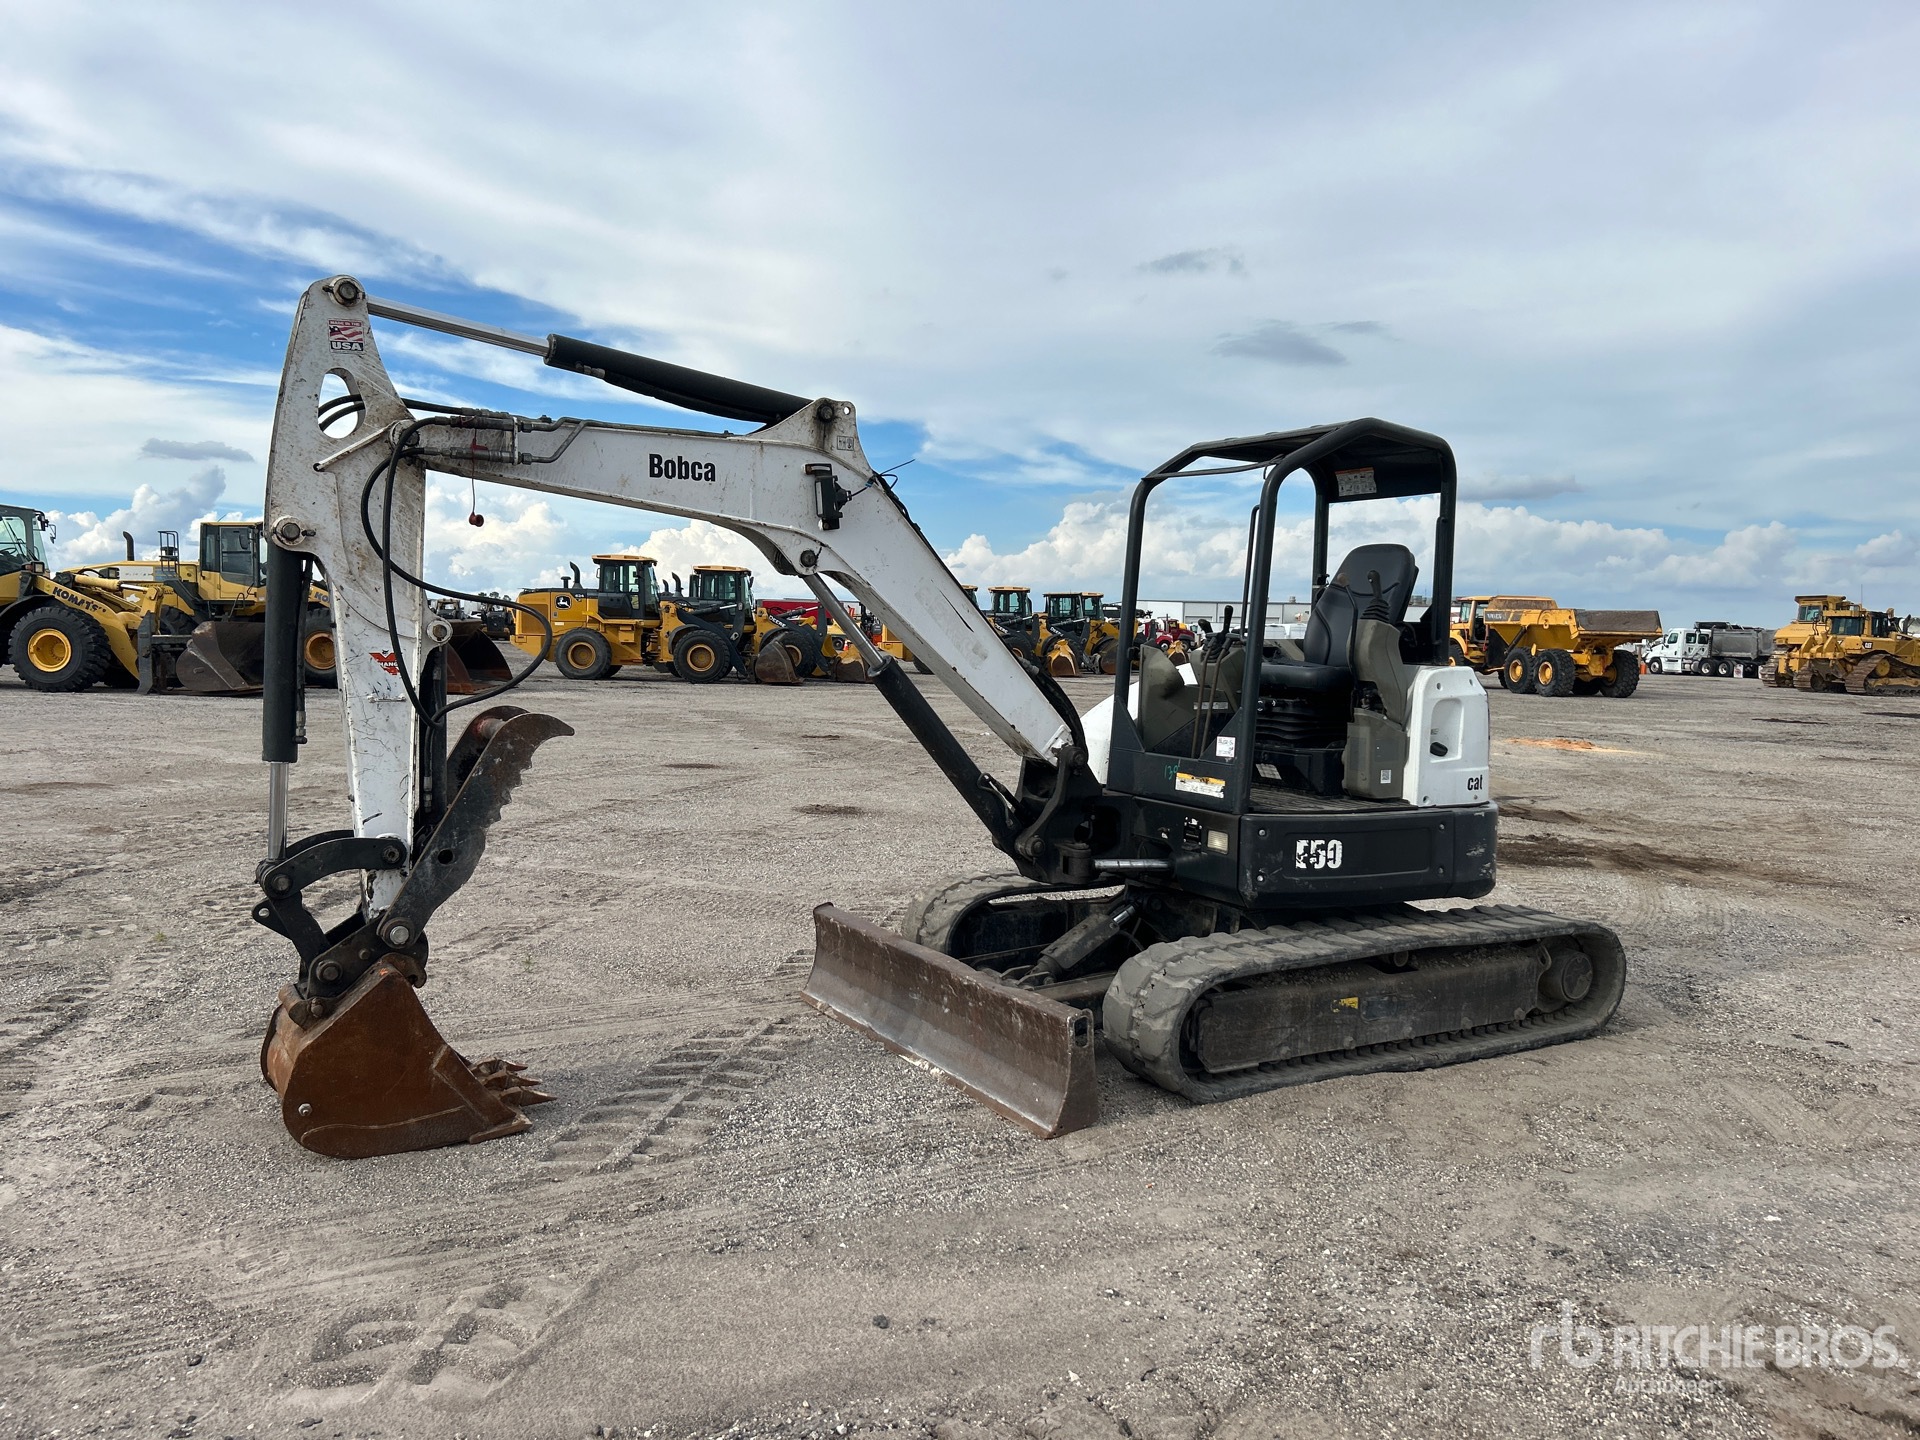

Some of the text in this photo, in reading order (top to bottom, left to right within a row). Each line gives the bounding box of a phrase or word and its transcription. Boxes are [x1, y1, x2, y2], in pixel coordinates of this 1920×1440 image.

[331, 341, 362, 351] USA
[649, 453, 716, 482] Bobca
[768, 614, 787, 628] DEERE
